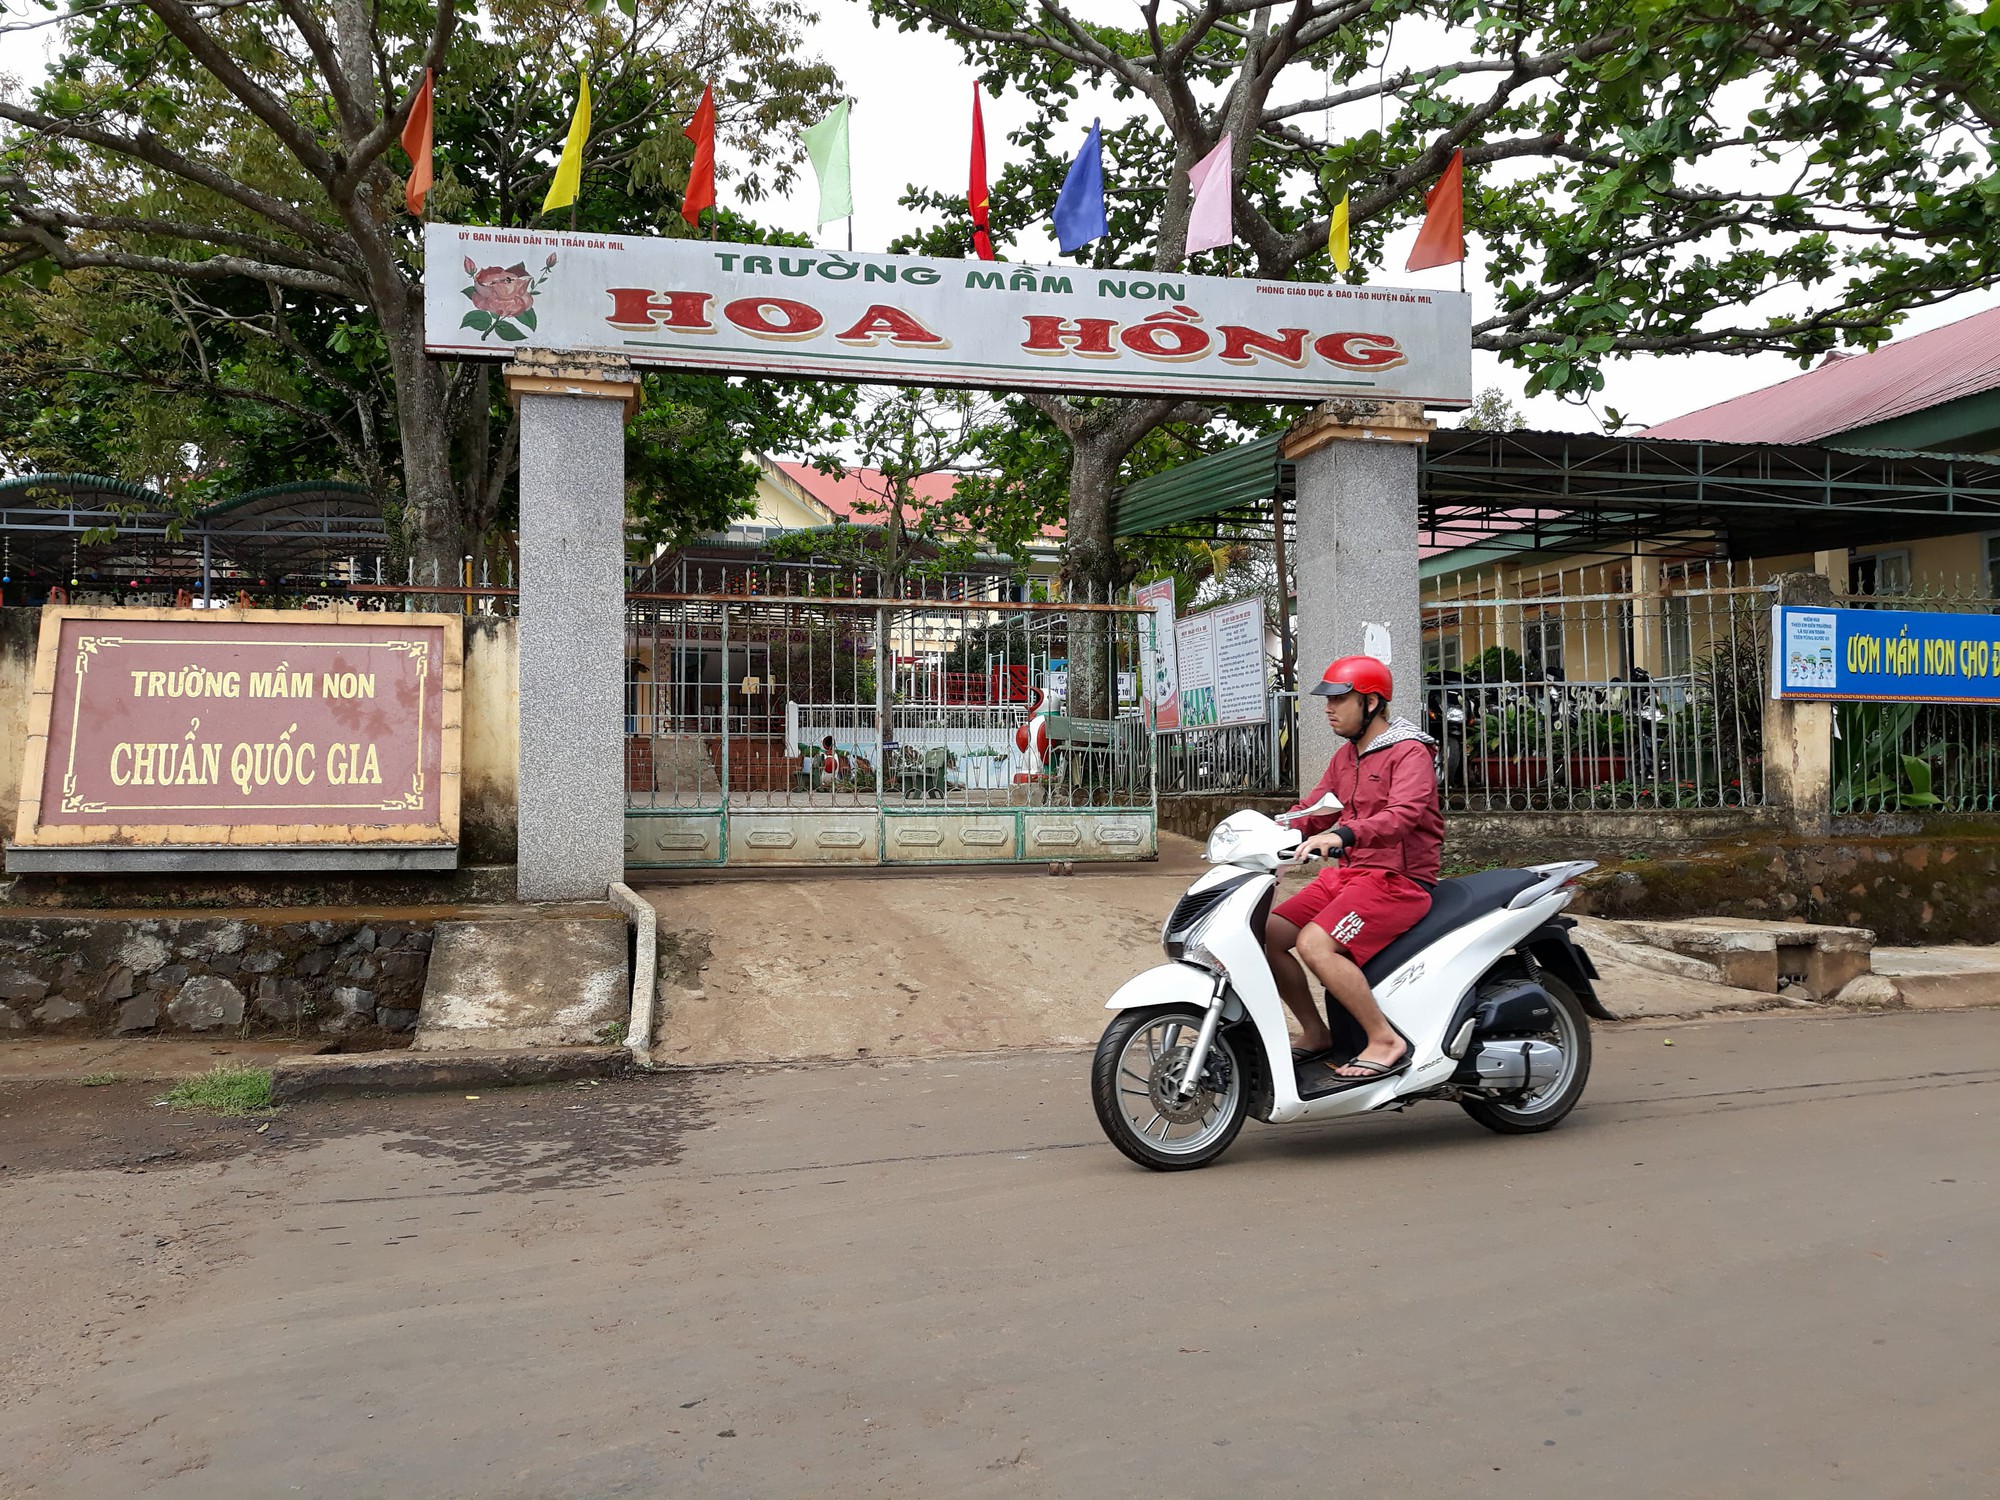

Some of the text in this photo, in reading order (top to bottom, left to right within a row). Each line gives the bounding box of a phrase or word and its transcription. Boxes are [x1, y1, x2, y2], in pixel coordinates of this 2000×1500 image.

[472, 232, 492, 242] BAN
[494, 233, 521, 244] NHÂN
[523, 234, 542, 245] DÂN
[544, 237, 558, 247] THỊ
[608, 241, 625, 251] MIL
[714, 252, 1186, 302] TRƯỜNG MẦM NON
[1256, 284, 1285, 295] PHÒNG
[1286, 286, 1306, 296] GIÁO
[1308, 288, 1325, 298] DỤC
[1327, 289, 1334, 298] &
[1336, 289, 1352, 299] ĐÀO
[1354, 291, 1369, 300] TẠO
[1371, 292, 1398, 303] HUYỆN
[1418, 295, 1433, 304] MIL
[604, 287, 1408, 372] HOA HỒNG
[130, 660, 376, 699] TRƯỜNG MẦM NON
[1847, 632, 1881, 674] ƯƠM
[1924, 638, 1955, 676] NON
[1960, 640, 1989, 680] CHO
[110, 717, 382, 796] CHUẨN QUỐC GIA
